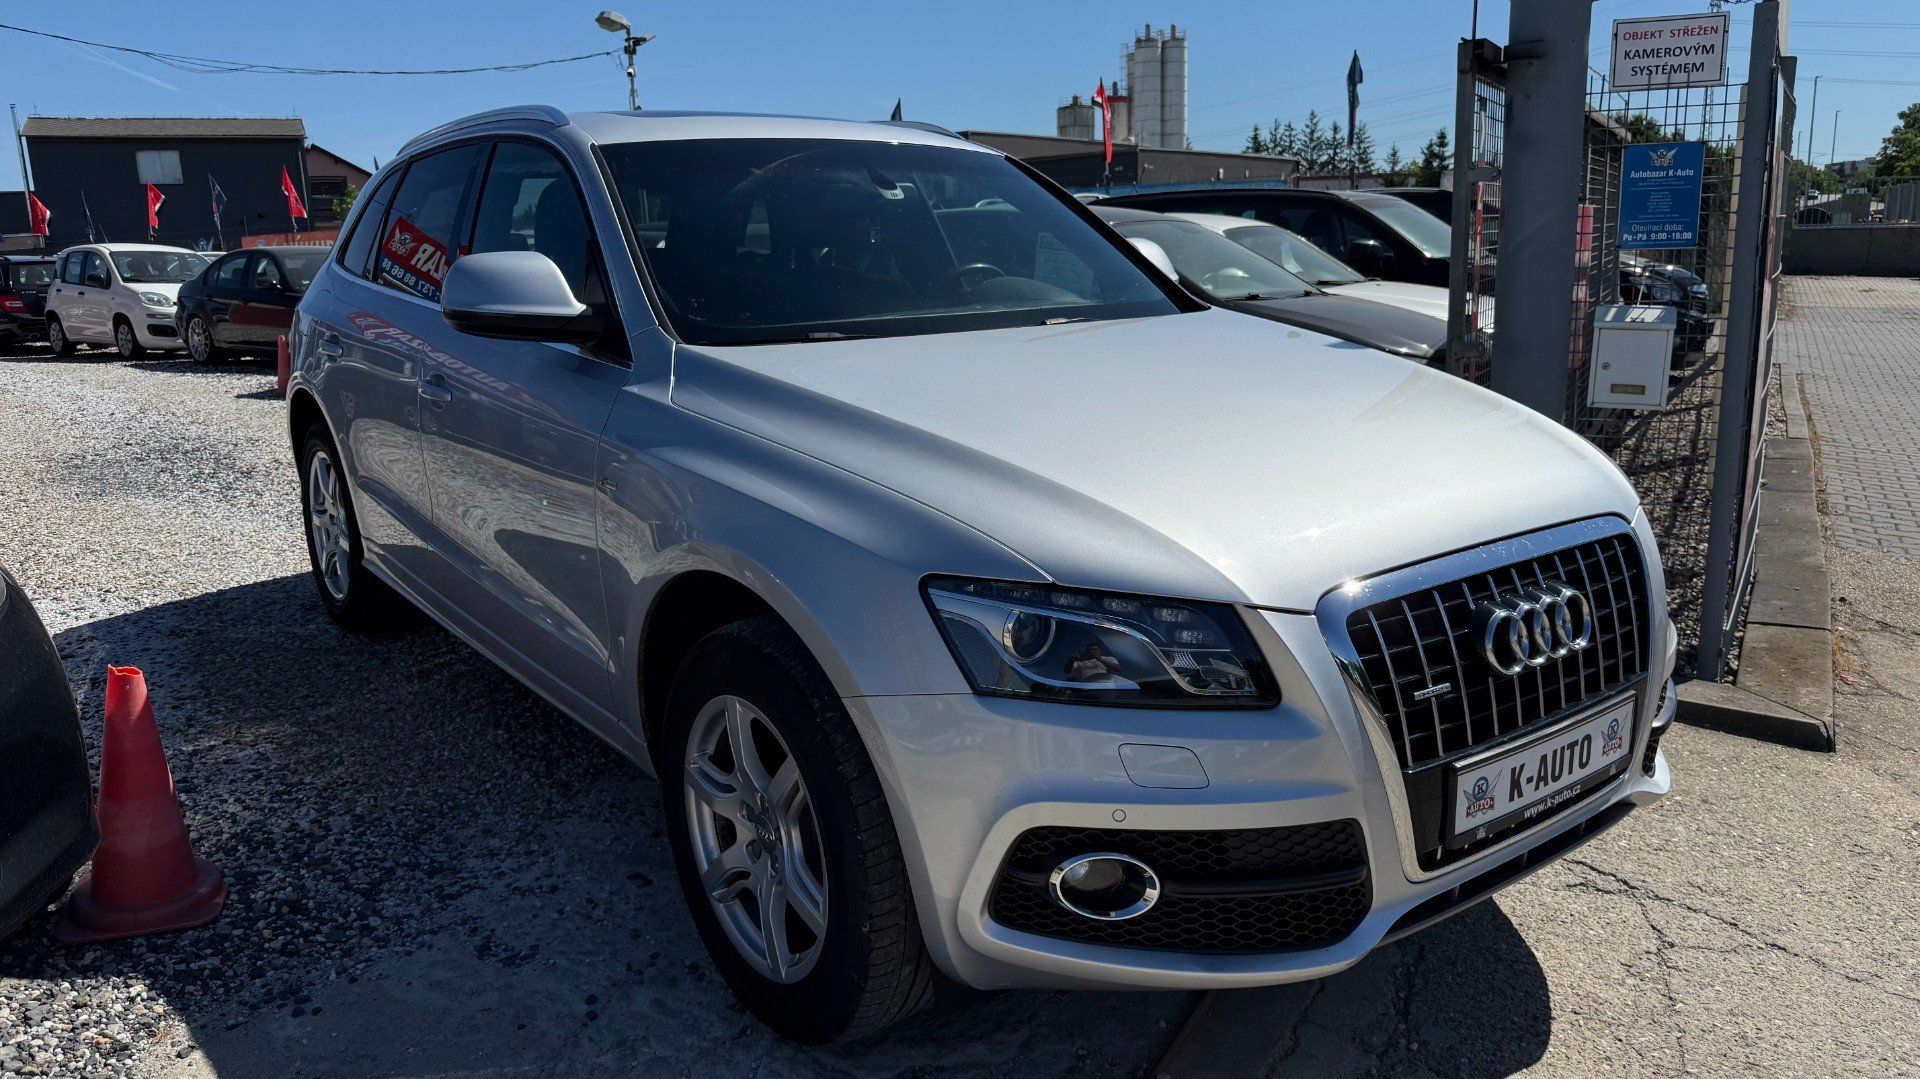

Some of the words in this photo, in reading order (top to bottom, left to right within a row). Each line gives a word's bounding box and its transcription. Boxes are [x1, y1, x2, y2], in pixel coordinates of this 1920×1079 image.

[1623, 29, 1664, 41] OBJEKT
[1669, 24, 1719, 38] STŘEŽEN
[1623, 42, 1715, 60] KAMEROVÝM
[1630, 61, 1705, 77] SYSTÉMEM
[1630, 170, 1667, 178] Autobazar
[1668, 168, 1694, 177] K-Auto
[1664, 223, 1684, 231] doba:
[1603, 738, 1621, 752] AUTO
[1508, 733, 1593, 803] K-AUTO
[1475, 782, 1485, 795] K
[1469, 799, 1491, 814] AUTO
[1524, 784, 1582, 819] www.k-auto.cz
